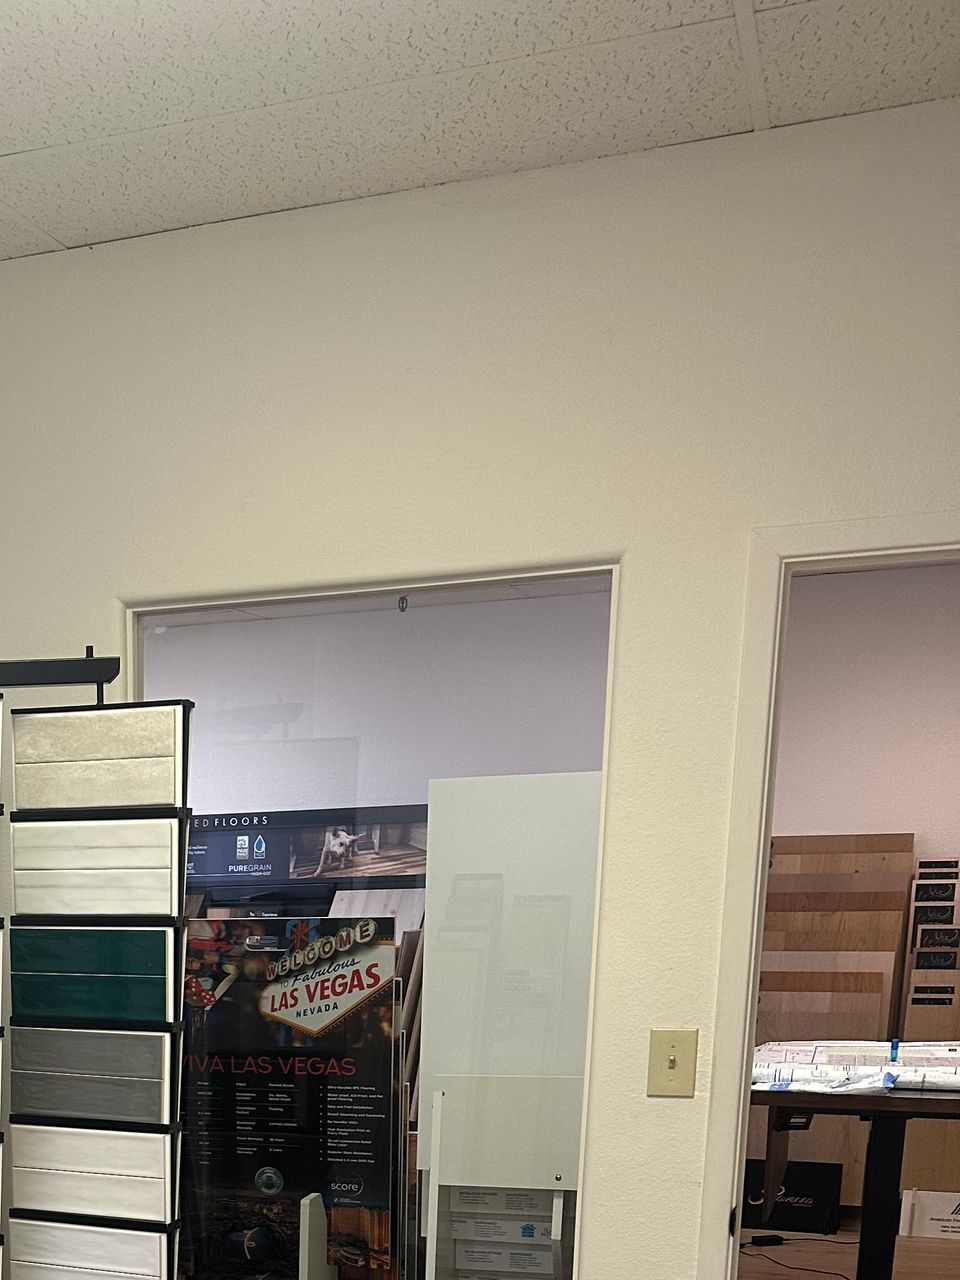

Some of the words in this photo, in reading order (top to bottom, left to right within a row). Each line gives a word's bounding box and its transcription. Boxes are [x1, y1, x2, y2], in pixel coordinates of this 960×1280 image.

[214, 816, 268, 826] FLOORS
[228, 864, 272, 872] PUREGRAIN
[266, 919, 373, 980] WELCOME
[292, 958, 361, 987] Fabulous
[270, 988, 298, 1012] LAS
[305, 962, 380, 1004] VEGAS
[296, 1002, 339, 1018] NEVADA
[182, 1055, 224, 1072] VIVA
[231, 1056, 272, 1074] LAS
[278, 1056, 356, 1076] VEGAS
[331, 1182, 358, 1192] score
